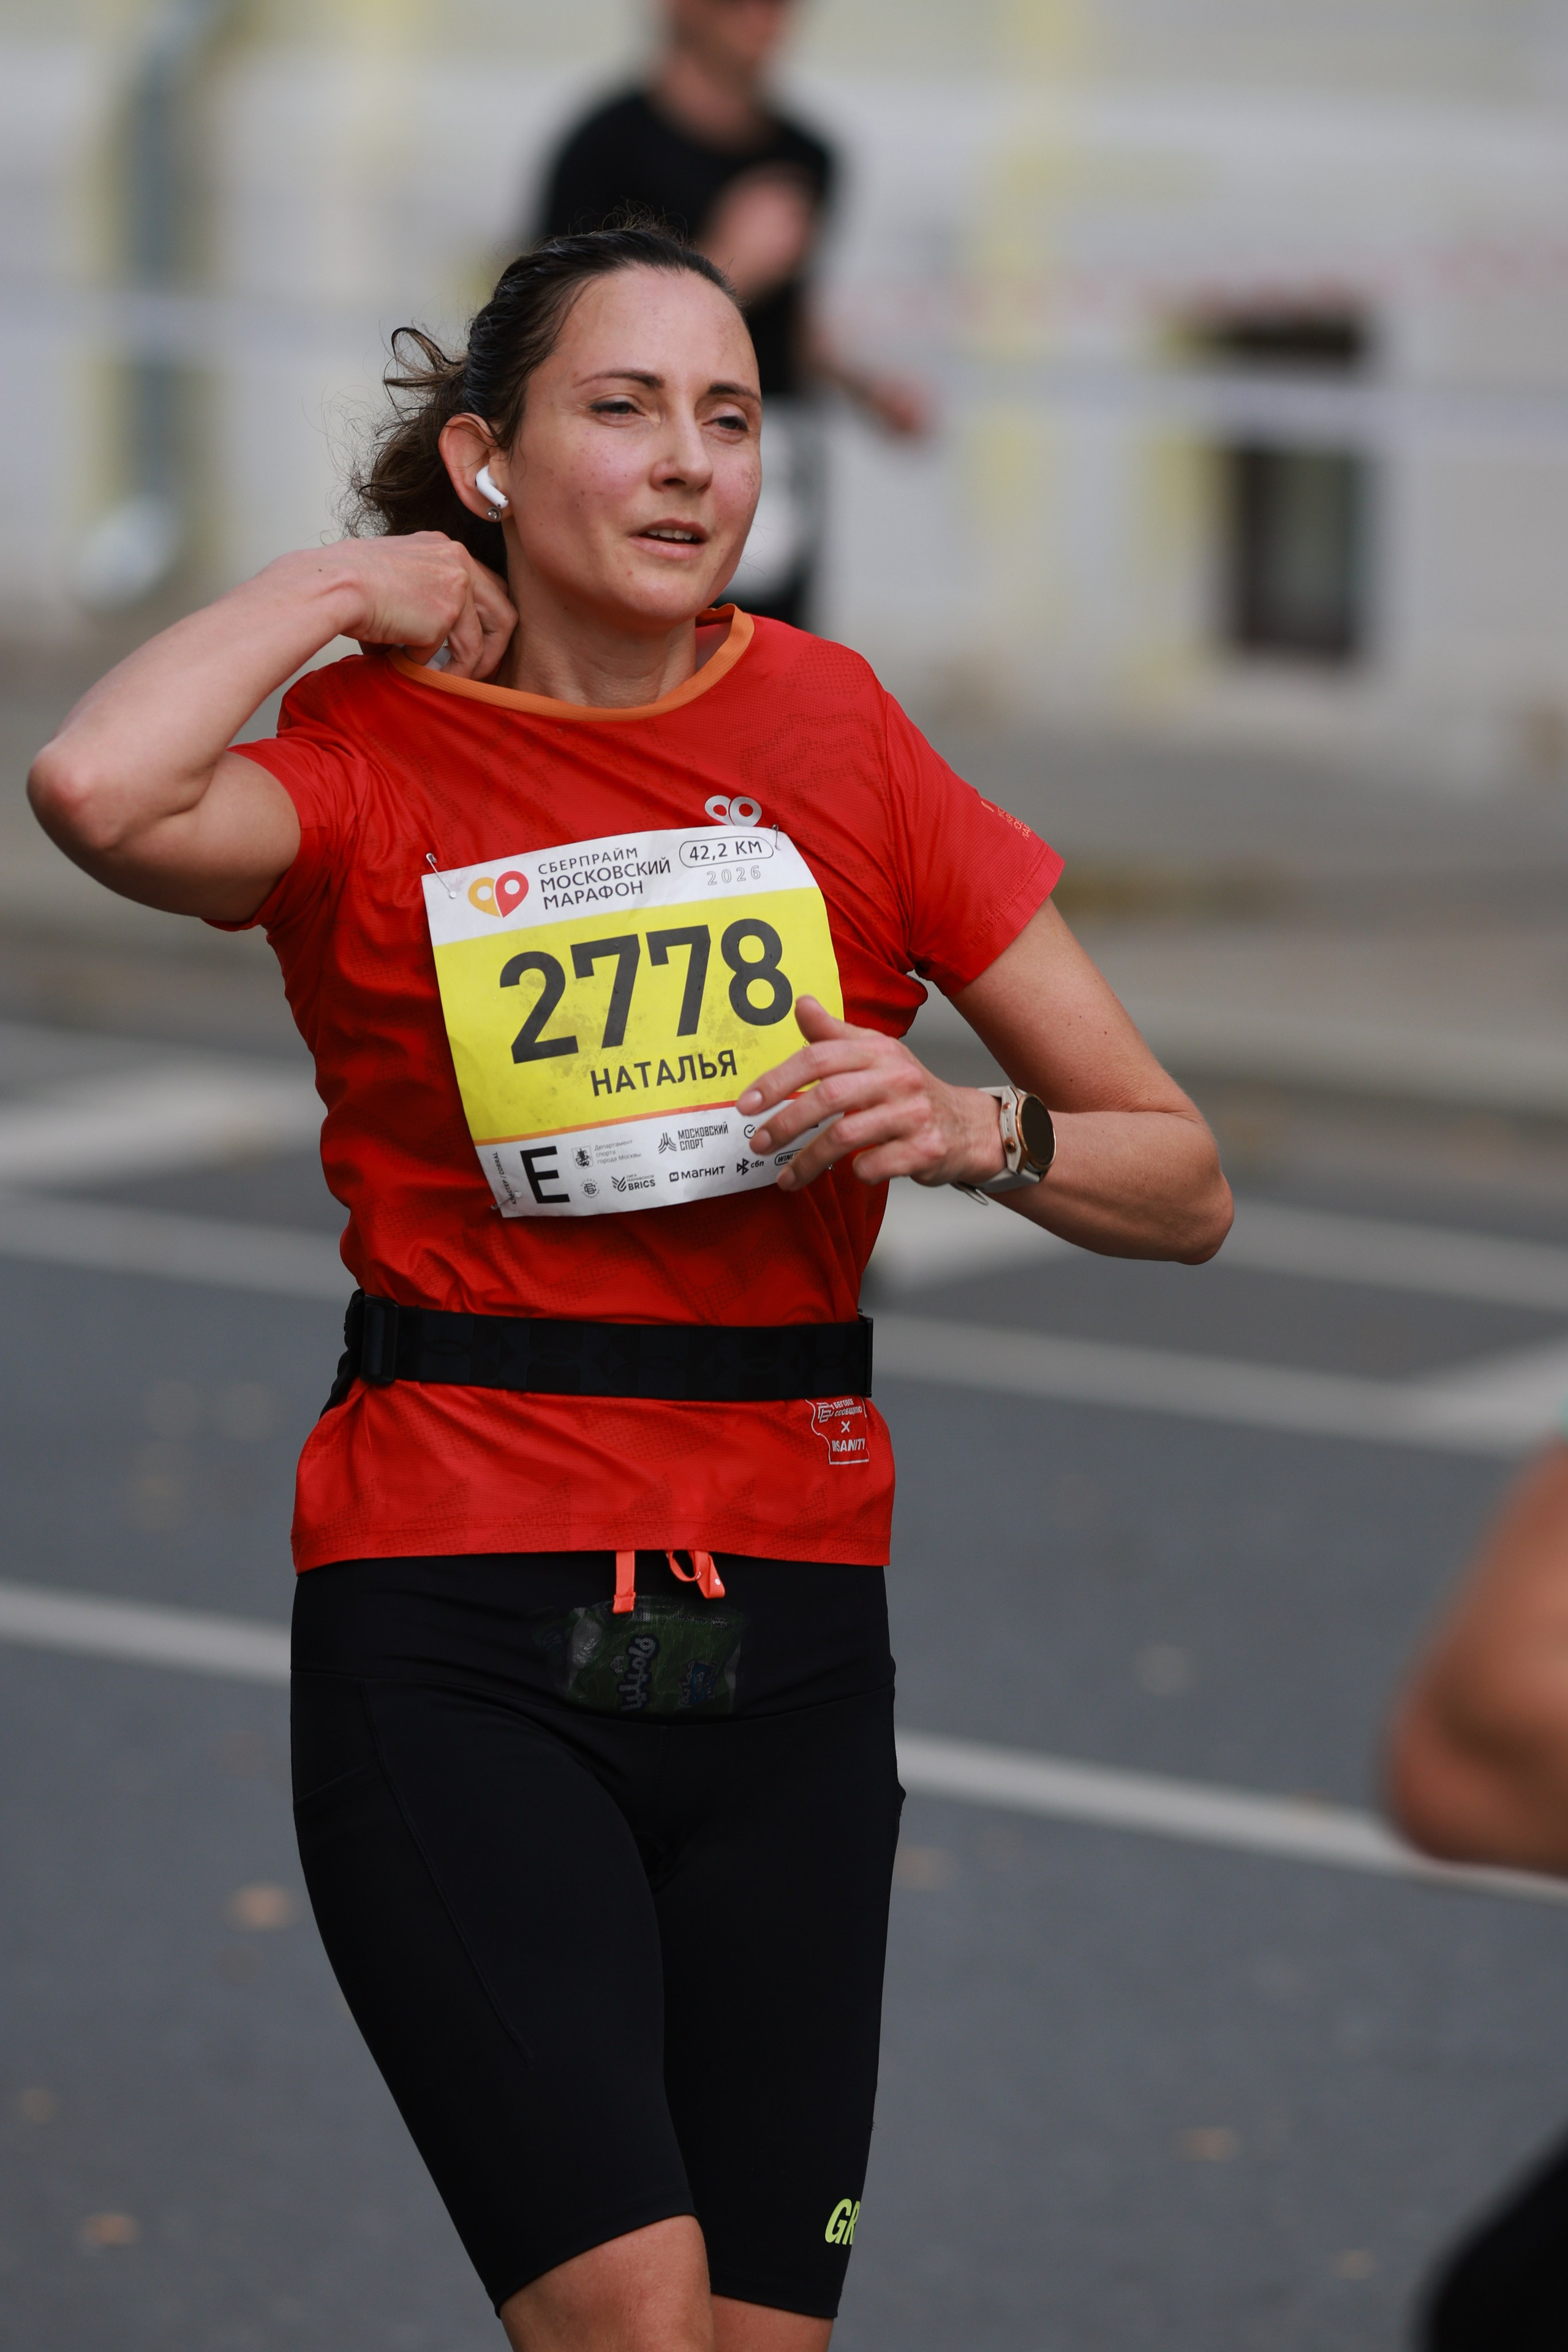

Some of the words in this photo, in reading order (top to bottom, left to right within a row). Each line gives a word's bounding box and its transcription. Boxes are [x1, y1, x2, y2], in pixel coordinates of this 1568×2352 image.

[538, 847, 638, 875] СБЕРПРАЙМ
[689, 843, 728, 861] 42,2
[735, 840, 762, 856] КМ
[540, 856, 671, 892] МОСКОВСКИЙ
[706, 865, 761, 886] 2026
[543, 880, 644, 910] МАРАФОН
[499, 918, 793, 1065] 2778
[590, 1049, 738, 1097] НАТАЛЬЯ
[677, 1121, 729, 1140] МОСКОВСКИЙ
[594, 1140, 633, 1152] Департамент
[679, 1138, 704, 1151] СПОРТ
[492, 1152, 505, 1175] CORRAL
[681, 1166, 725, 1180] магнит
[750, 1159, 764, 1169] сбп
[519, 1145, 570, 1205] E
[628, 1179, 656, 1191] BRICS
[832, 1438, 865, 1452] INSANITY
